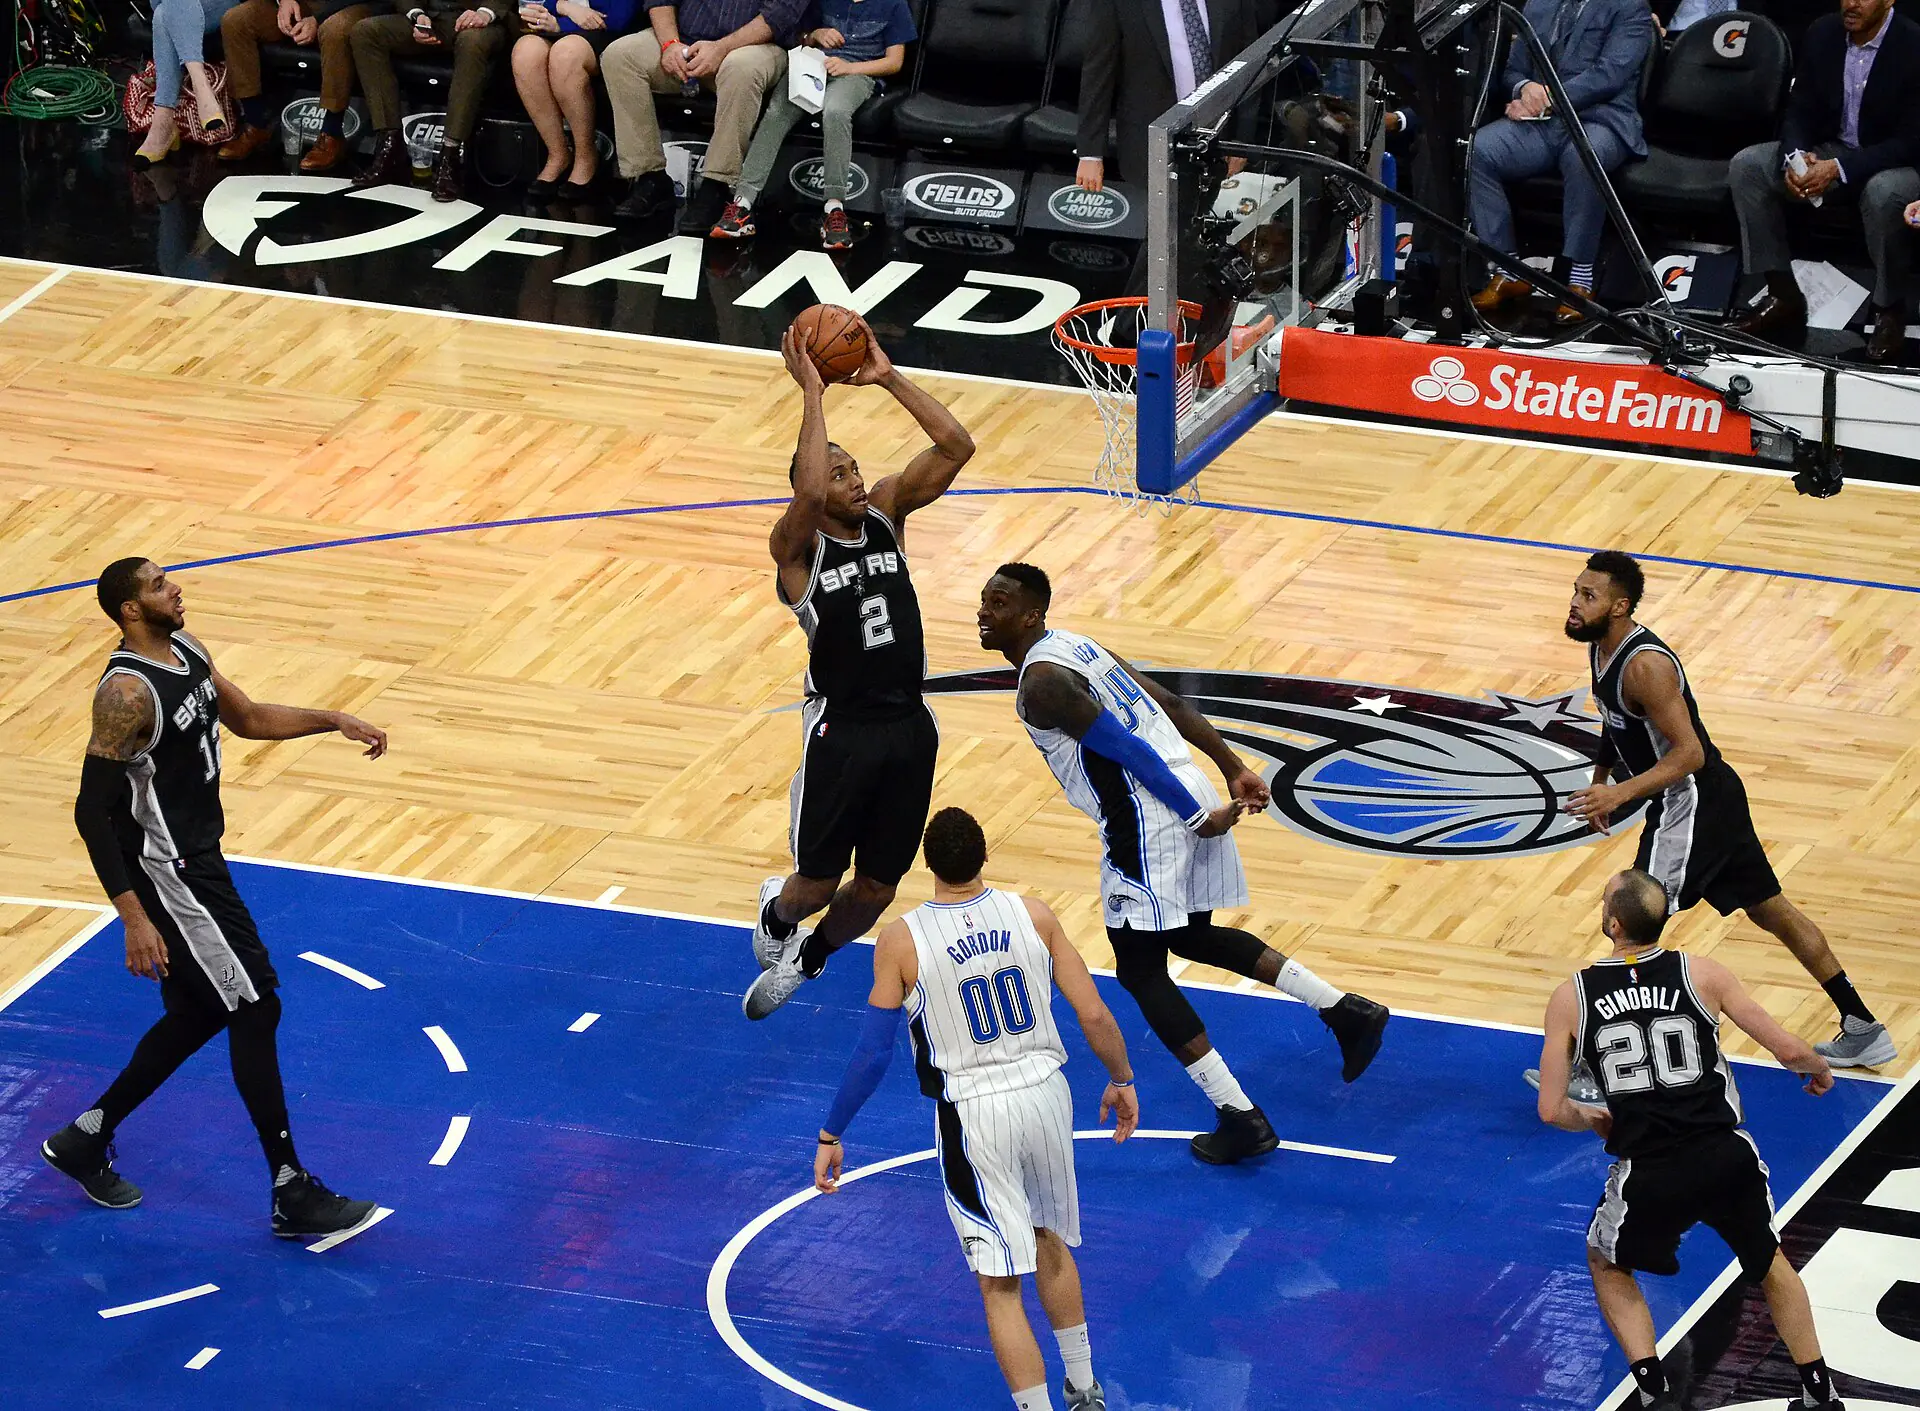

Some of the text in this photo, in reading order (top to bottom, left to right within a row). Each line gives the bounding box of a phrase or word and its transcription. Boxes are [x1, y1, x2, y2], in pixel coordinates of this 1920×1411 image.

[299, 104, 328, 119] LAN
[411, 123, 446, 144] FIE
[807, 164, 825, 177] LA
[921, 183, 1000, 207] FIELDS
[1065, 191, 1107, 206] LAND
[954, 207, 1005, 219] AUTO GROUP
[1066, 204, 1114, 219] ROVER
[432, 215, 1116, 348] FAND
[860, 593, 895, 650] 2
[947, 930, 1011, 965] GORDON
[958, 965, 1036, 1045] 00
[1594, 986, 1680, 1020] GINOBILI
[1594, 1013, 1703, 1096] 20
